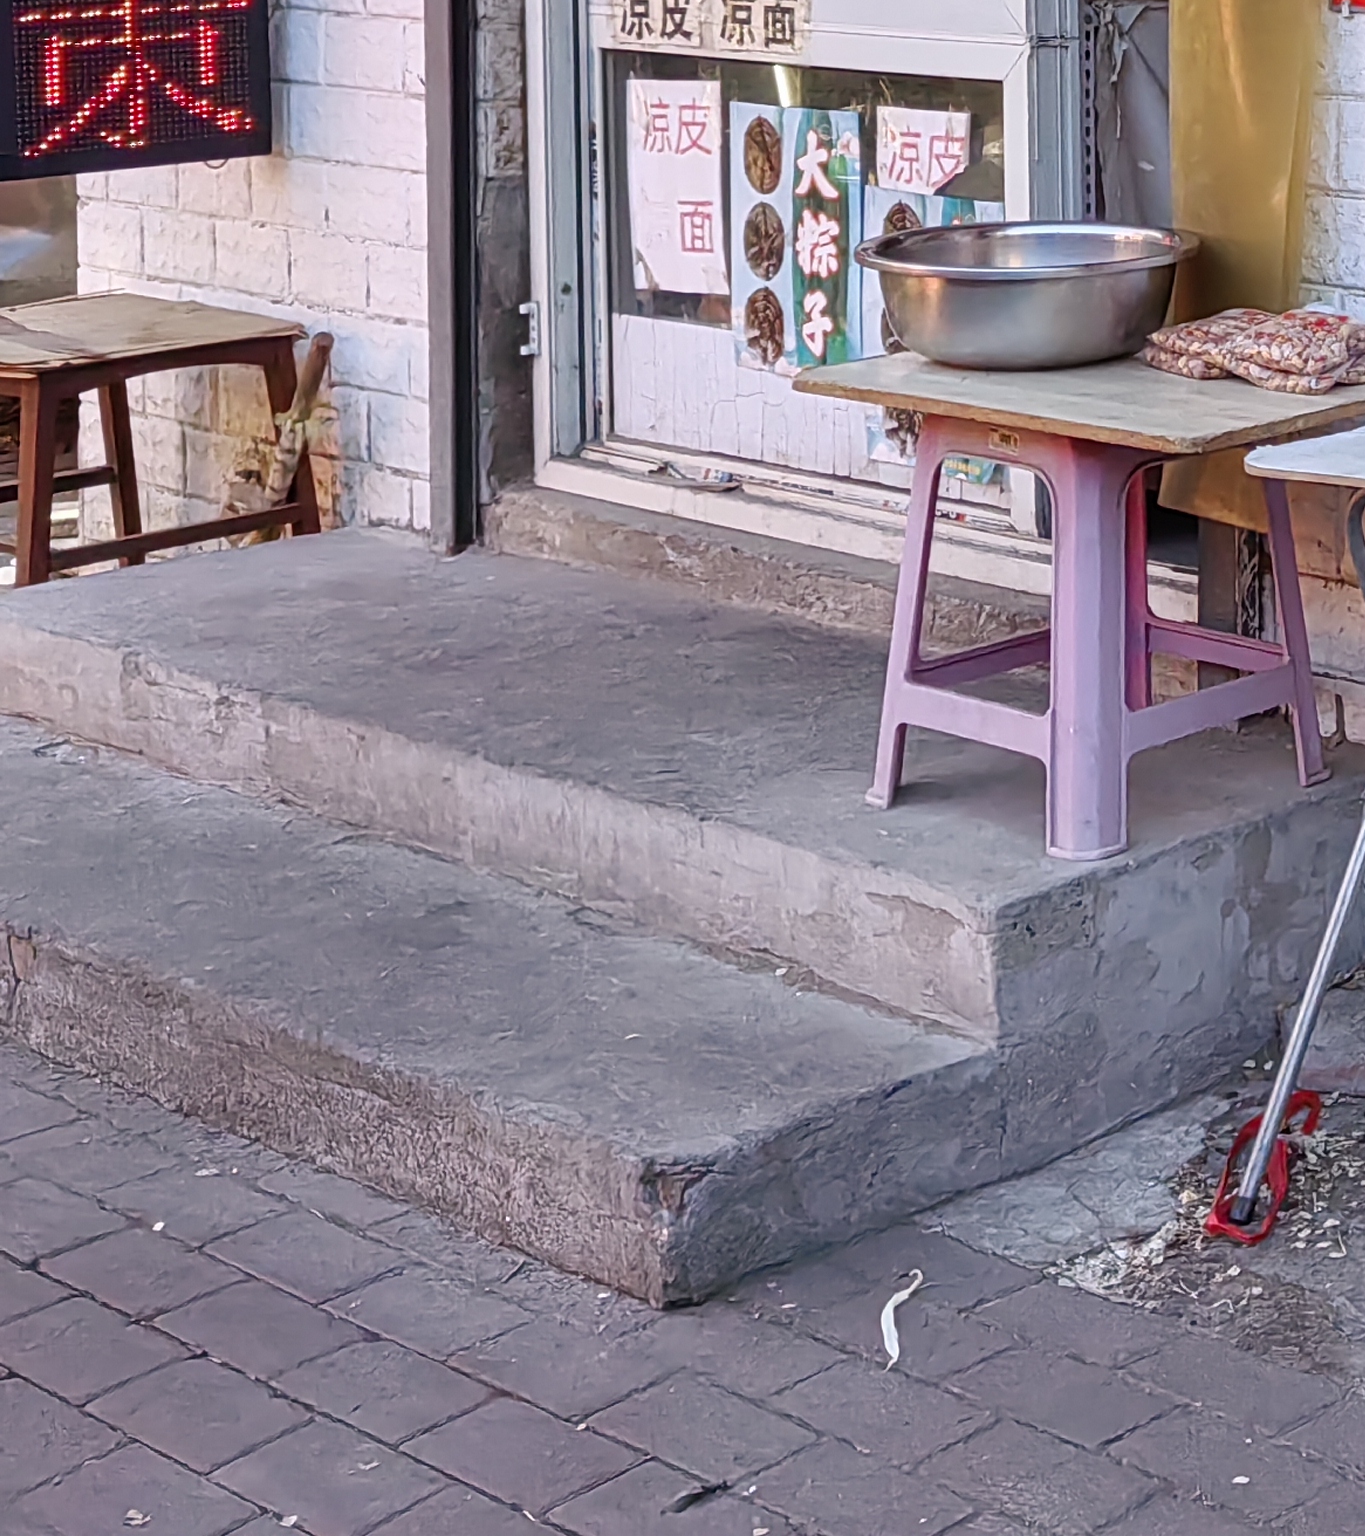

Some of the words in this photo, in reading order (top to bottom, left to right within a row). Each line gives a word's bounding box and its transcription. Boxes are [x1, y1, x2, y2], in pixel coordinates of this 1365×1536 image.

[642, 98, 713, 156] 凉皮
[886, 131, 967, 190] 凉皮
[795, 130, 841, 358] 大粽子
